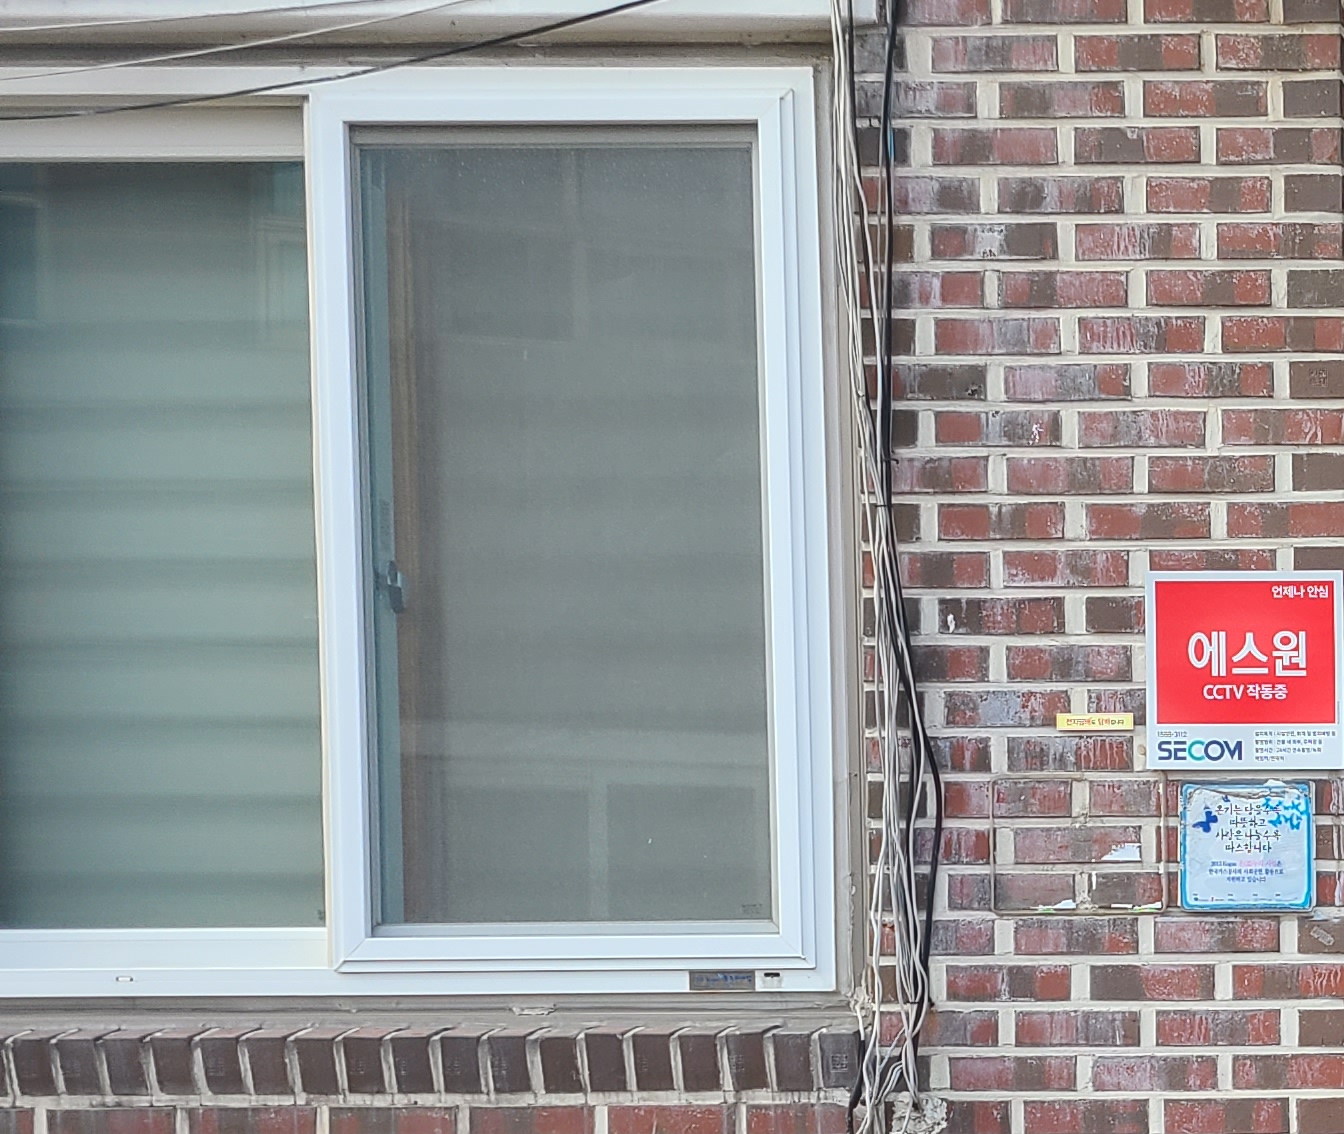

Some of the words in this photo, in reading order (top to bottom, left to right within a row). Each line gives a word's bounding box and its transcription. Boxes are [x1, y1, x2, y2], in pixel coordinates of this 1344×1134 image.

[1272, 585, 1305, 598] 언제나
[1307, 585, 1329, 598] 안심
[1188, 630, 1307, 677] 에스원
[1203, 685, 1244, 700] CCTV
[1247, 684, 1288, 701] 작동중
[1157, 739, 1243, 762] SECOM
